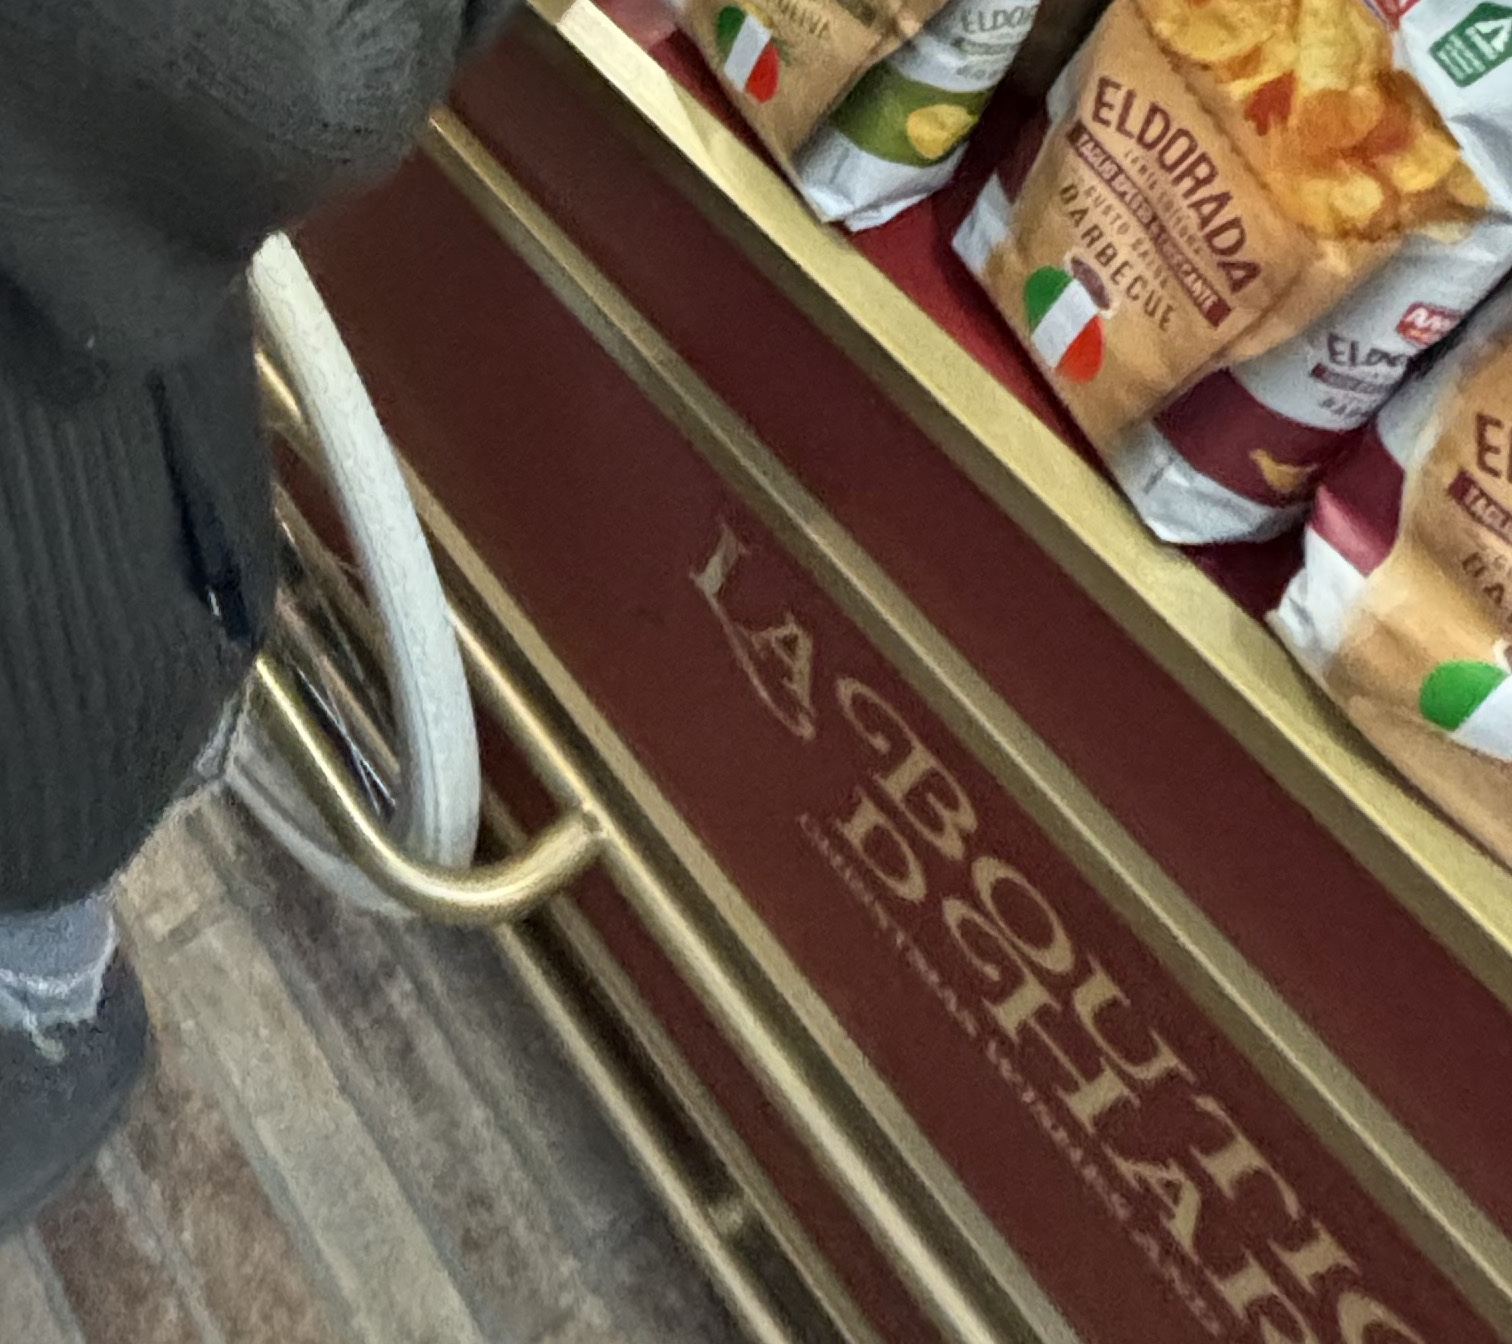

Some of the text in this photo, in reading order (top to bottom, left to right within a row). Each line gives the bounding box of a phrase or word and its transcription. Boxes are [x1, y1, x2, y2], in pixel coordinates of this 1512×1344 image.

[1059, 182, 1177, 333] BARBECUE
[1091, 76, 1263, 295] ELDORADA
[689, 519, 816, 740] LA
